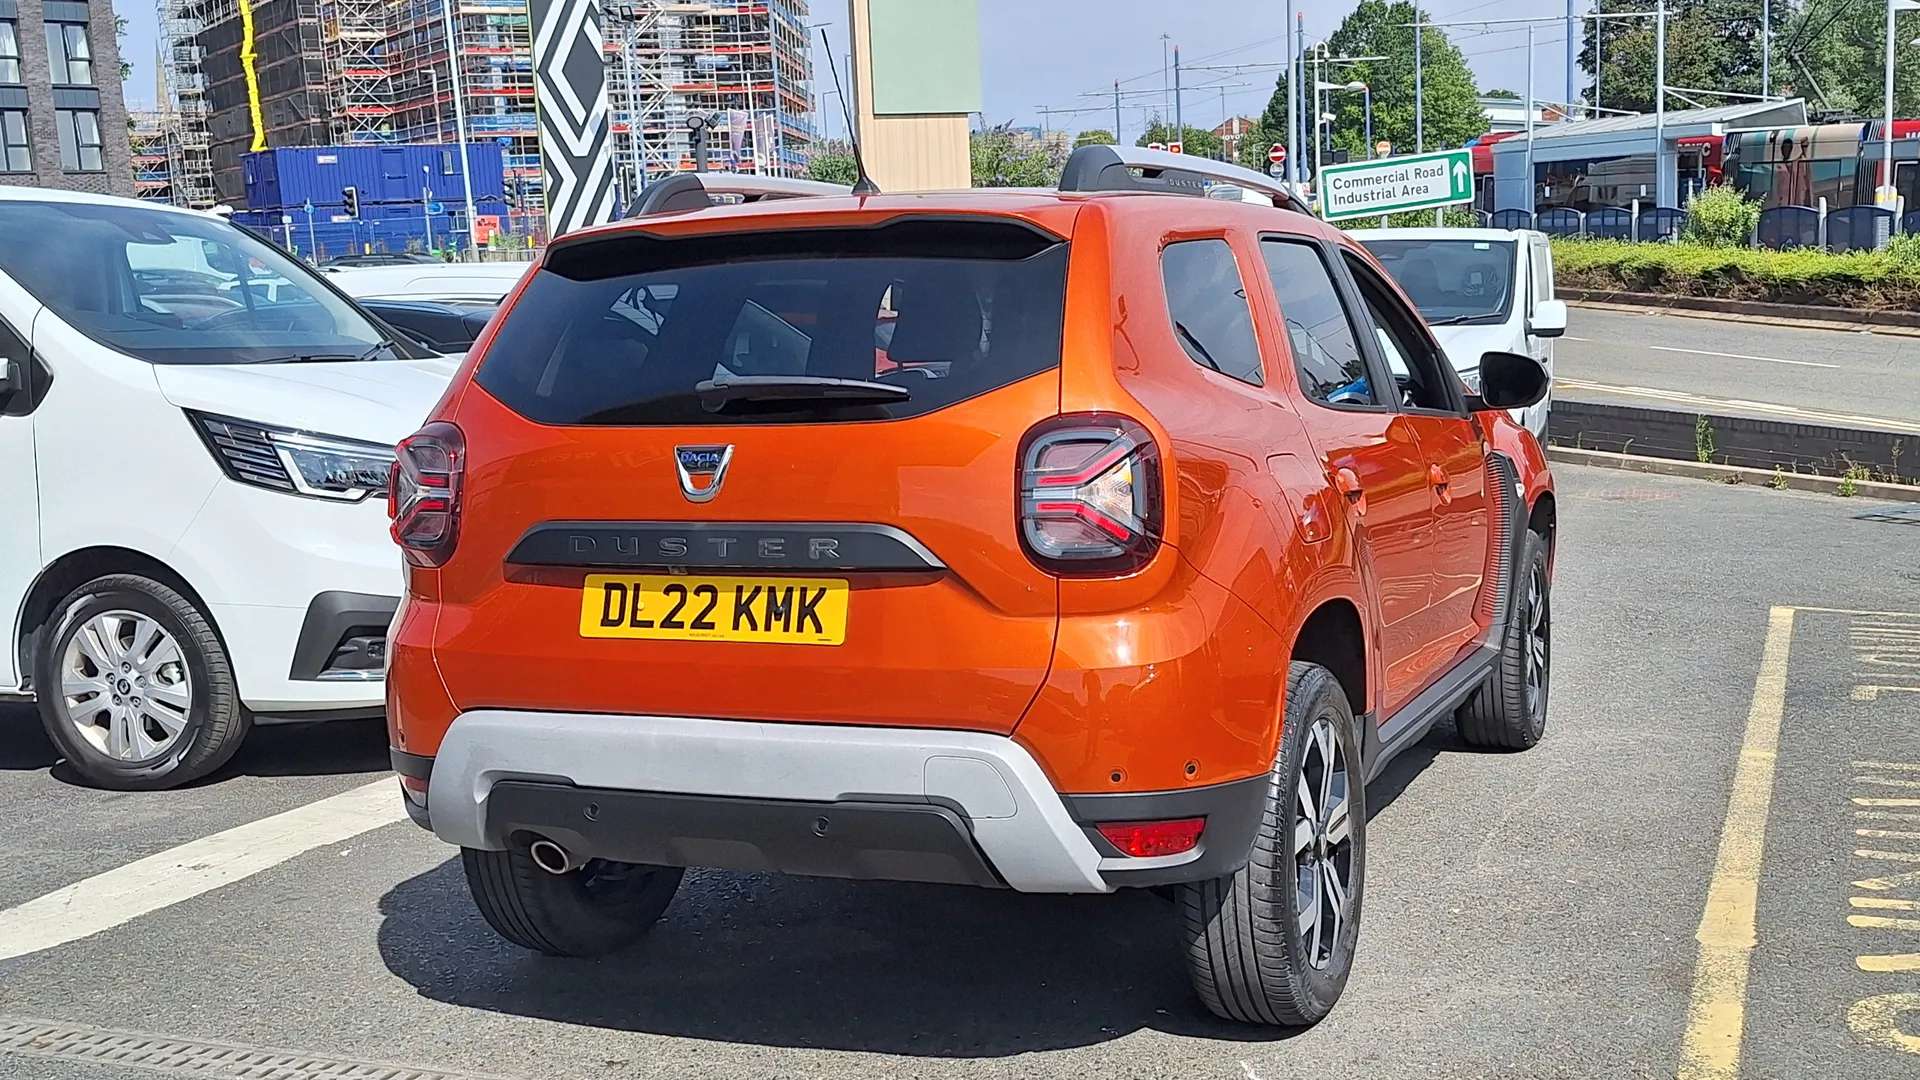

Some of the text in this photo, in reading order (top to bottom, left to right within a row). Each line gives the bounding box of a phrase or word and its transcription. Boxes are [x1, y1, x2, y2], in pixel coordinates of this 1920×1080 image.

[1332, 164, 1444, 190] Commercial Road
[1334, 184, 1429, 206] Industrial Area
[680, 451, 719, 462] DACIA
[569, 535, 840, 559] DUSTER
[600, 582, 827, 633] DL22 KMK
